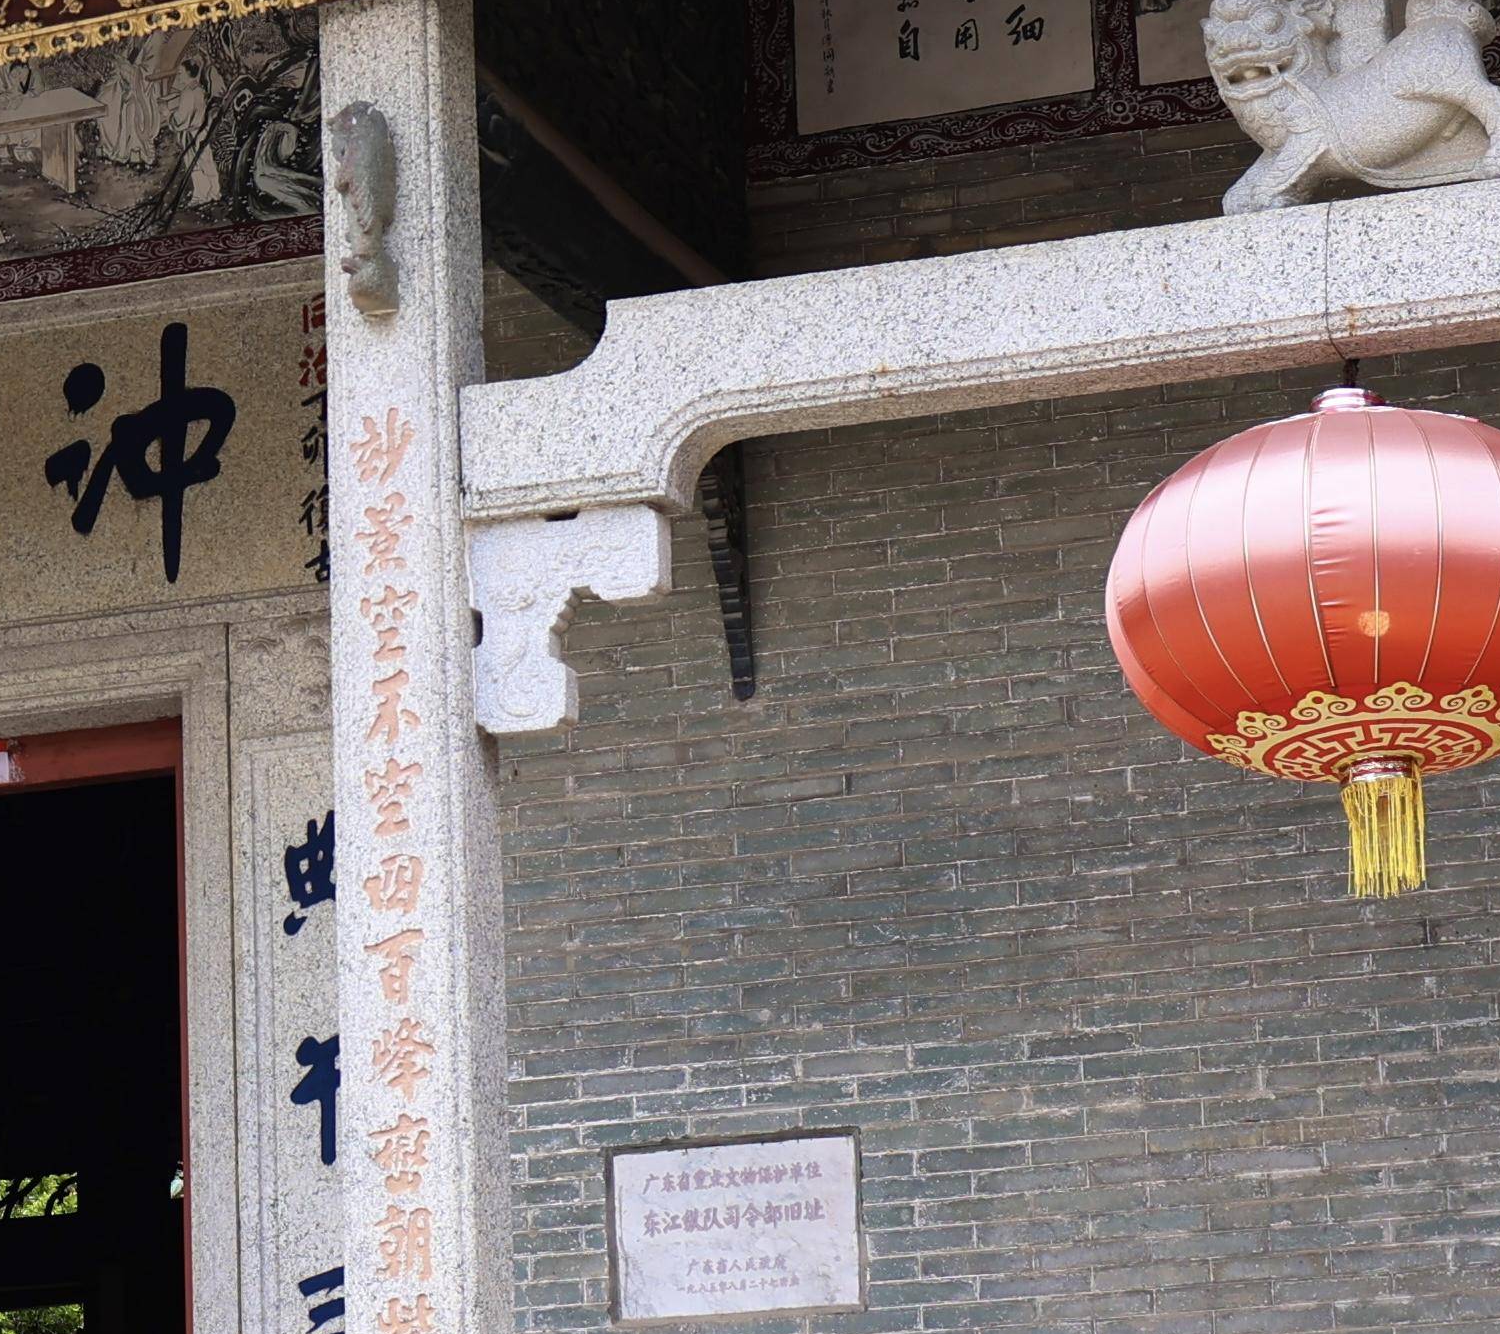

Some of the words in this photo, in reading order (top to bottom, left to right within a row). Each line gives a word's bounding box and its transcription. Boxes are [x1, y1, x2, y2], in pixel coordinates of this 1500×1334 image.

[642, 1161, 823, 1195] 广东省重点文物保护单位
[643, 1197, 826, 1238] 东江纵队司令部旧址
[686, 1254, 787, 1277] 广东省人民政府
